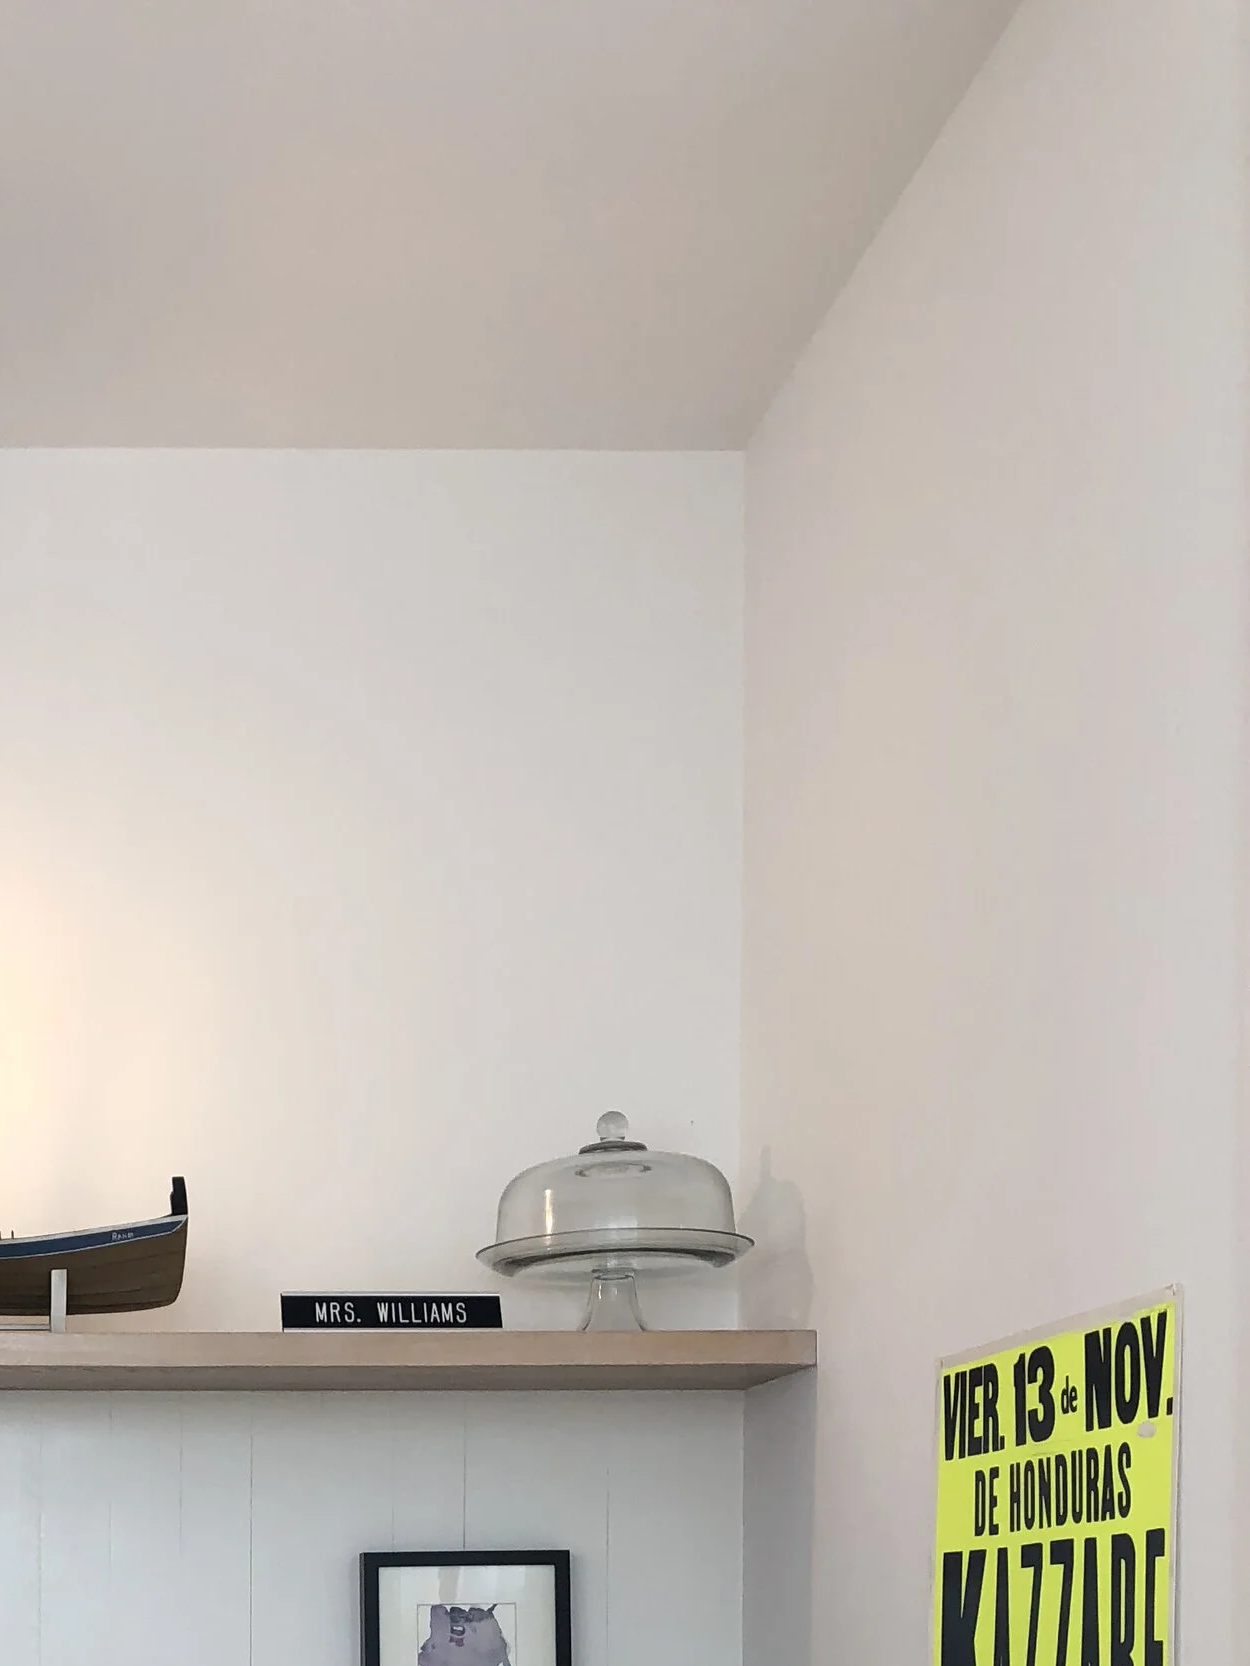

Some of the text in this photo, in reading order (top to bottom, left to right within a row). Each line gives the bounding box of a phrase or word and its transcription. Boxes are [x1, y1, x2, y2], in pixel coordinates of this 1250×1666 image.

[315, 1302, 467, 1323] MRS. WILLIAMS
[943, 1309, 1174, 1461] VIER. 13 de NOV.
[974, 1442, 1132, 1537] DE HONDURAS
